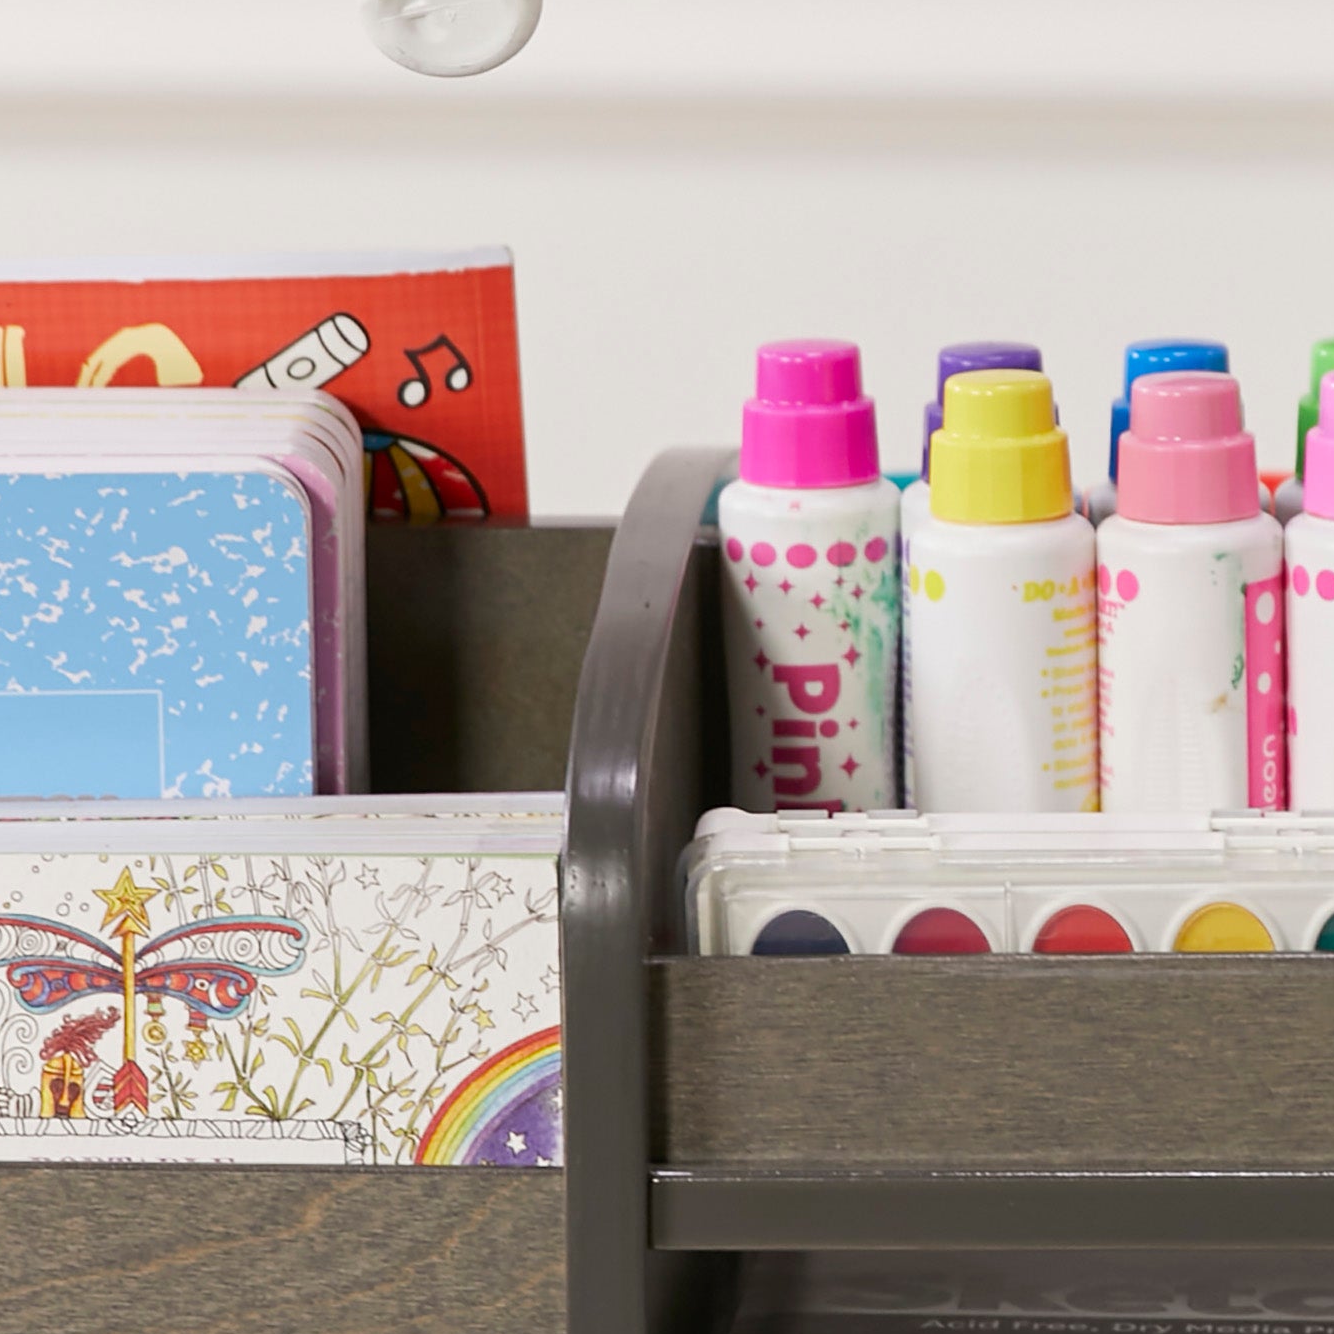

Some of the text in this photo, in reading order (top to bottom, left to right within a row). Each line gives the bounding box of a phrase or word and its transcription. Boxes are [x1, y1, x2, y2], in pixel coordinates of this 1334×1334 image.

[771, 663, 844, 810] Pin
[919, 1318, 1000, 1331] Acid
[1012, 1319, 1098, 1334] Free,
